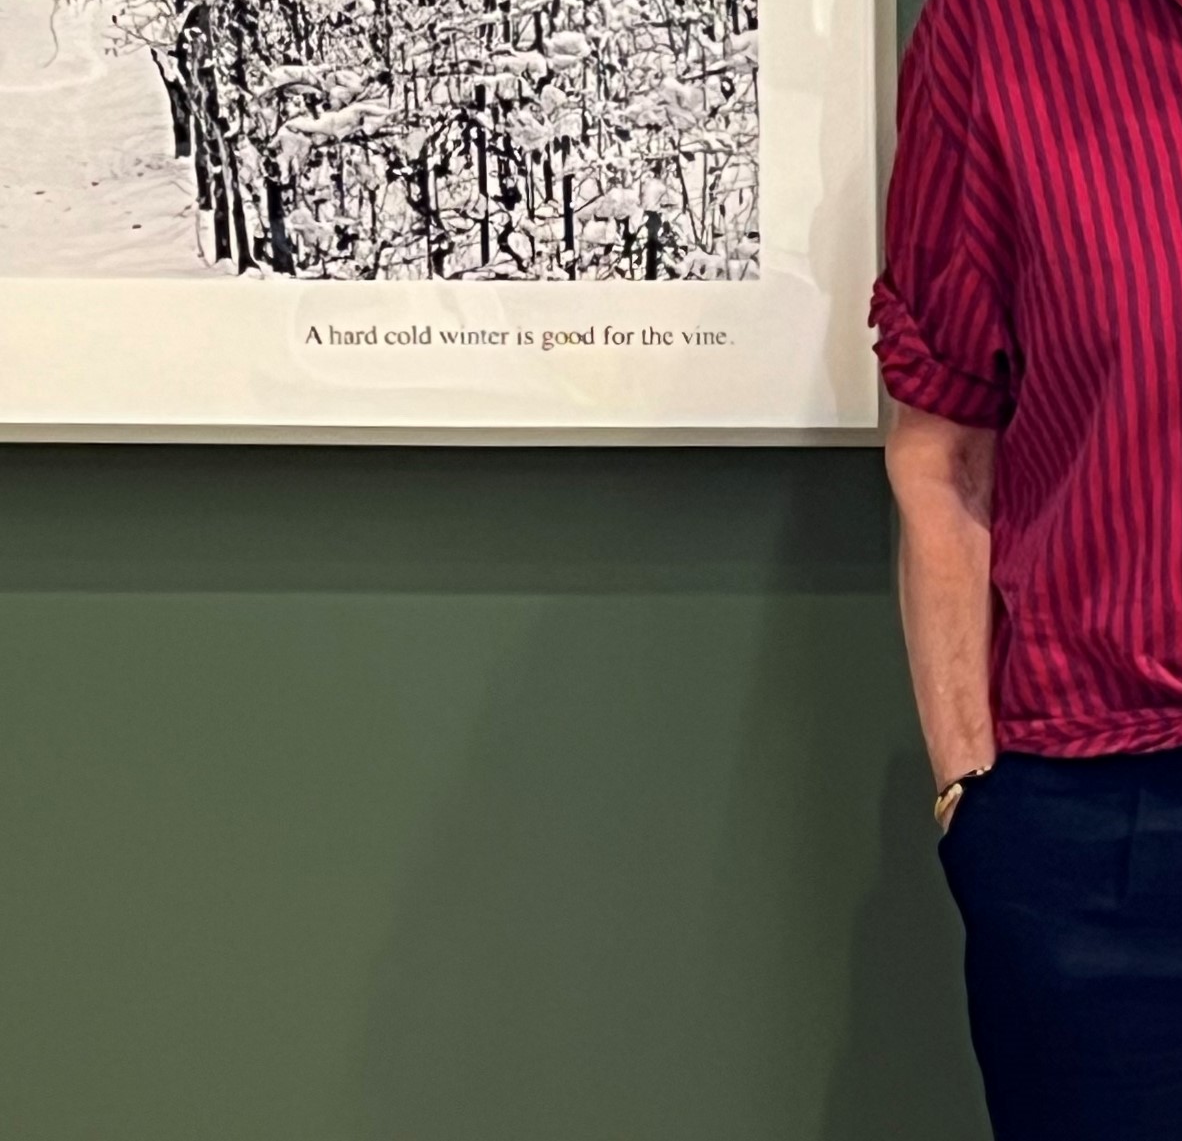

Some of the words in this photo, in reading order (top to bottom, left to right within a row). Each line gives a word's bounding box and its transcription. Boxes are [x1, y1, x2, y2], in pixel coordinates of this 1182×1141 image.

[305, 325, 323, 346] A
[328, 324, 378, 346] hard
[383, 324, 432, 346] cold
[438, 326, 510, 346] winter
[516, 326, 535, 346] is
[541, 325, 596, 352] good
[603, 324, 635, 346] for
[641, 325, 674, 346] the
[681, 326, 734, 346] vine.
